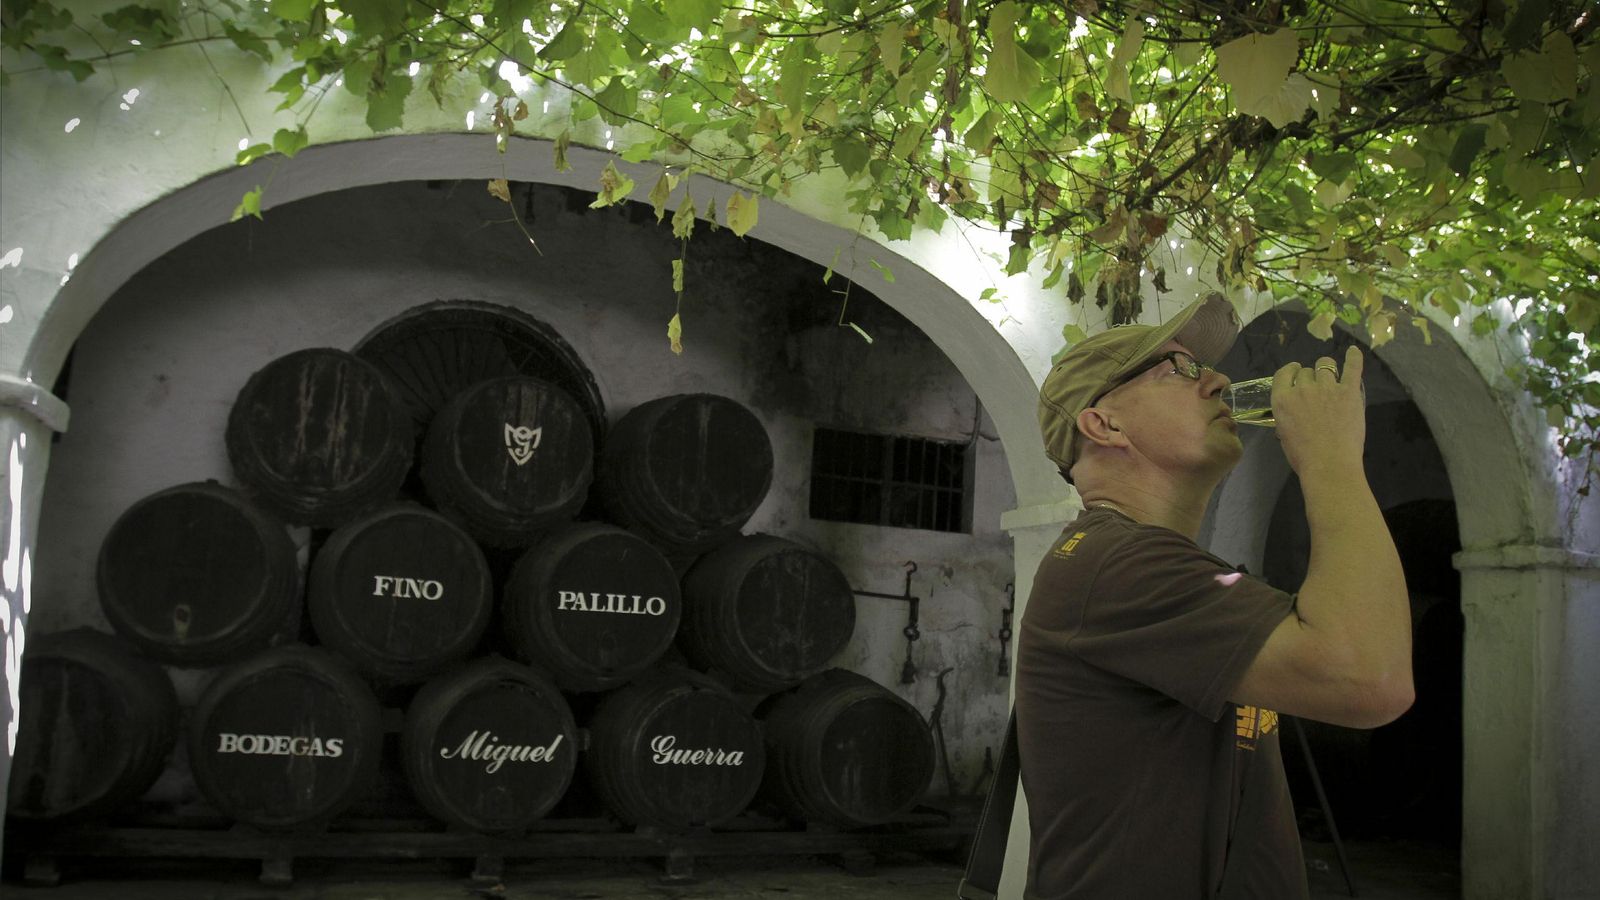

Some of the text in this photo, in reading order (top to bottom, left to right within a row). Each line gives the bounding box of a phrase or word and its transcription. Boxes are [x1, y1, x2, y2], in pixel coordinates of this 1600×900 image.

[372, 575, 444, 601] FINO
[557, 590, 666, 616] PALILLO
[217, 730, 744, 774] BODEGAS Miguel Guerra
